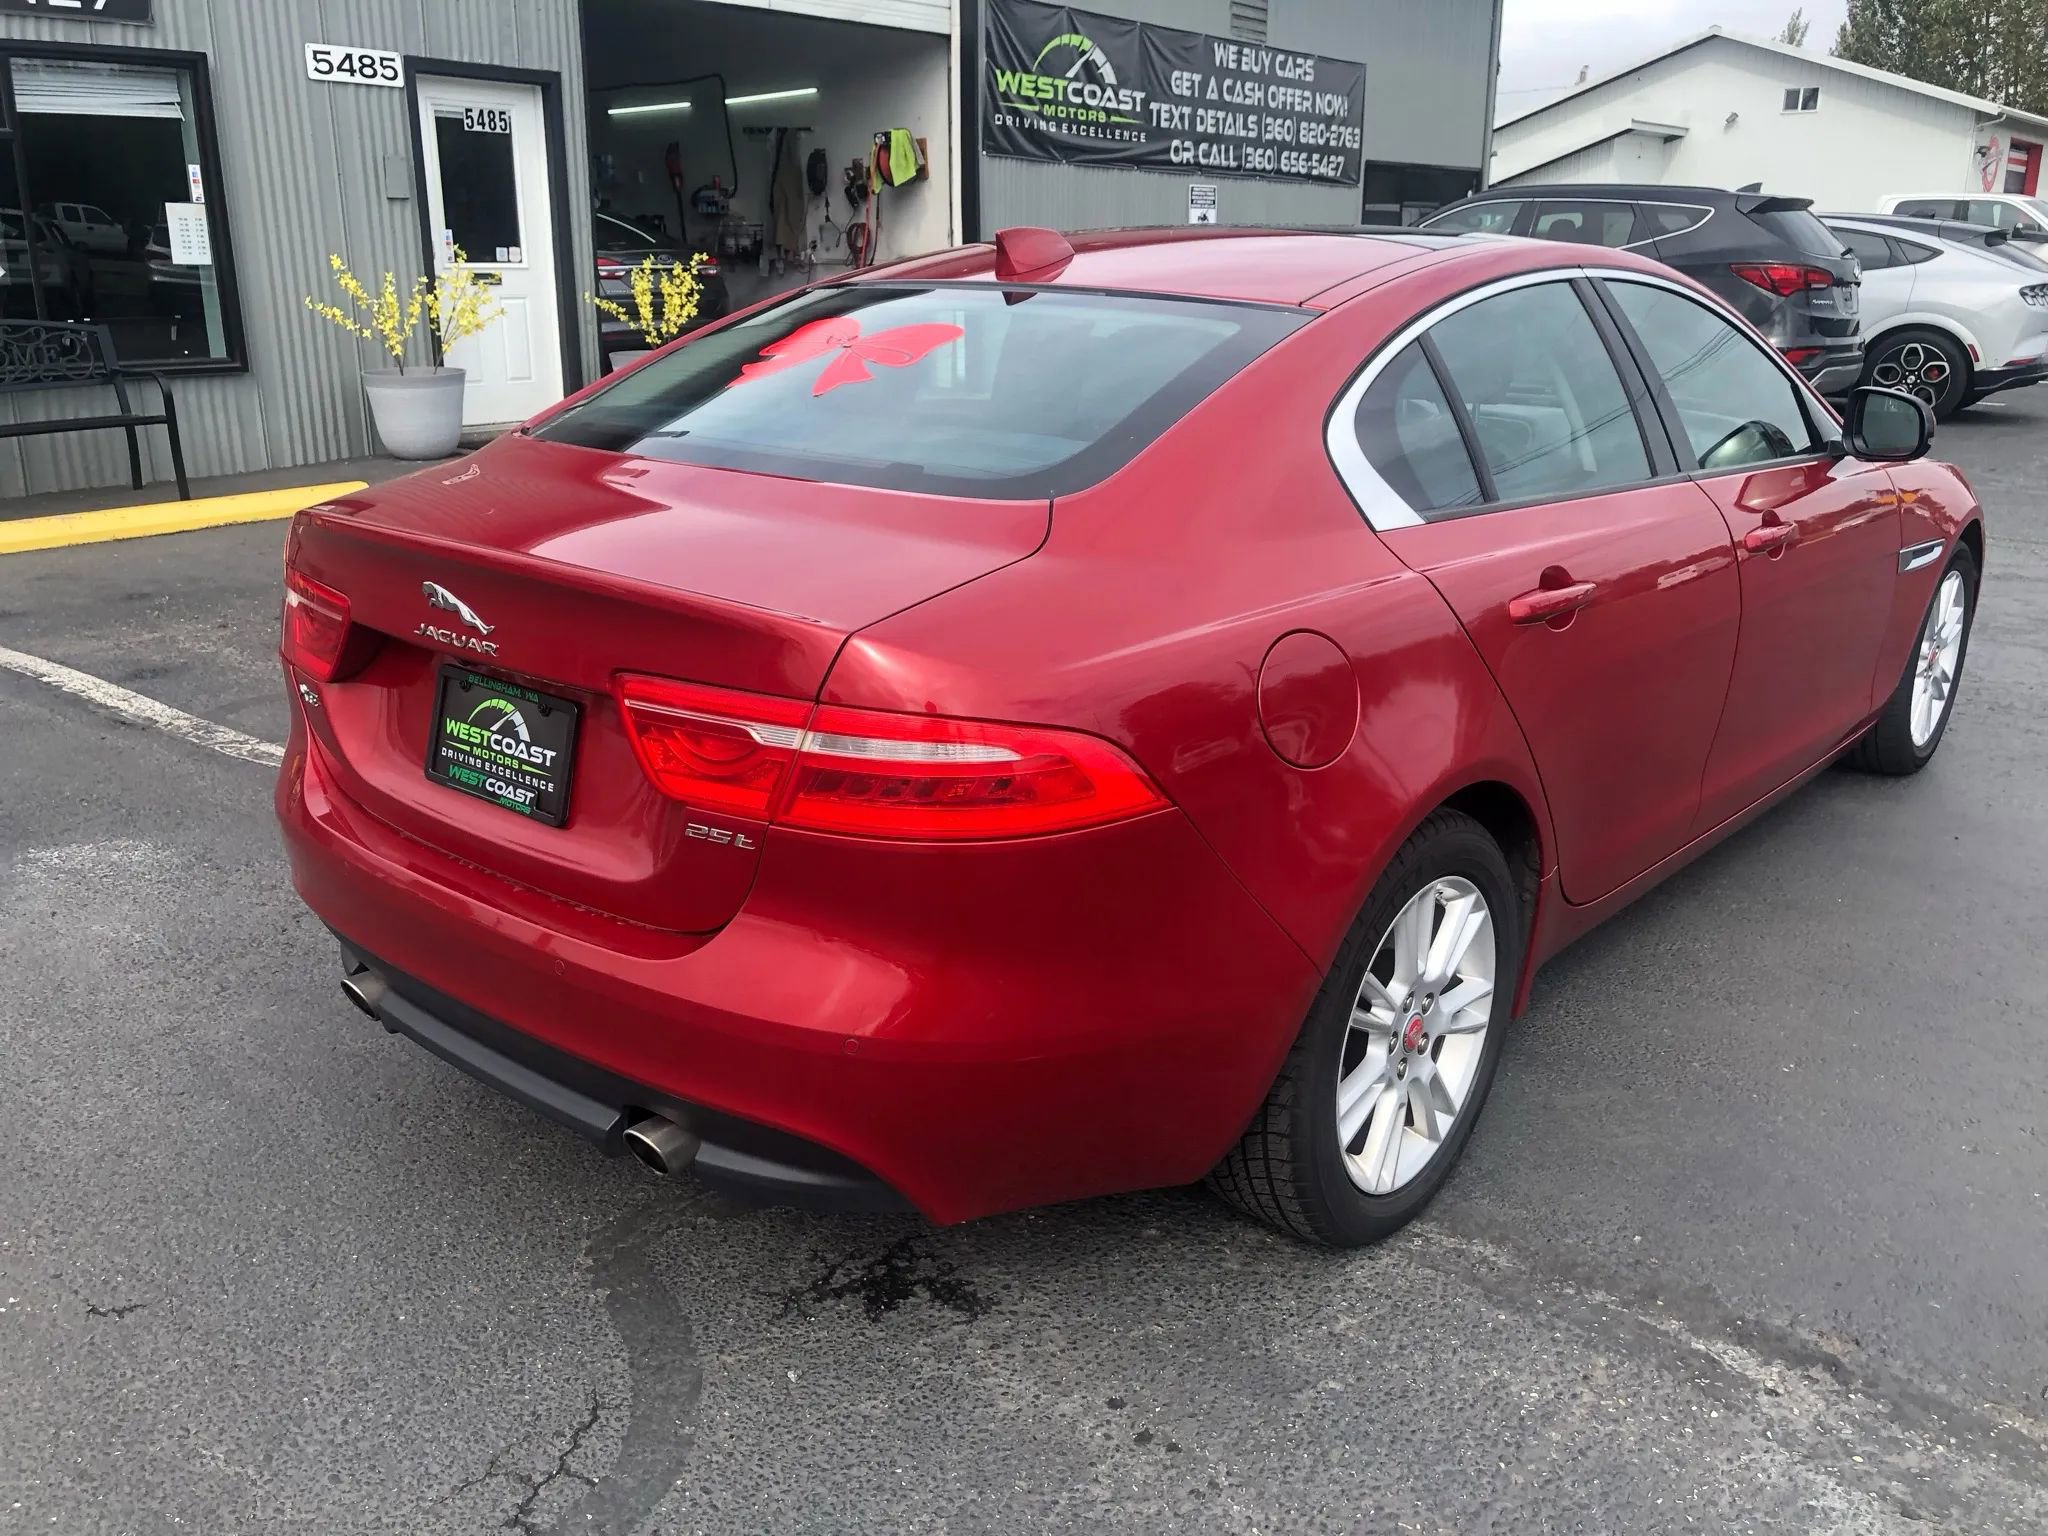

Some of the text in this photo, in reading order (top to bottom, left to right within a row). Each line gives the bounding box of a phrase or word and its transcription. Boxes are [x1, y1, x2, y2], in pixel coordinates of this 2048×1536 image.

[312, 49, 399, 81] 5485
[1214, 42, 1315, 82] WE BUY CARS
[995, 69, 1146, 112] WESTCOAST
[1171, 70, 1348, 118] GET A CASH OFFER NOW!
[464, 108, 508, 132] 5485
[994, 114, 1147, 143] DRIVING EXCELLENCE
[1043, 104, 1107, 123] MOTORS
[1149, 101, 1361, 149] TEXT DETAILS (360) 820-2763
[1170, 139, 1345, 177] OR CALL (360) 656-5427
[413, 623, 500, 657] JAGUAR
[446, 717, 557, 767] WESTCOAST
[472, 746, 519, 769] MOTORS
[441, 747, 554, 792] DRIVING EXCELLENCE
[499, 796, 531, 814] MOTORS
